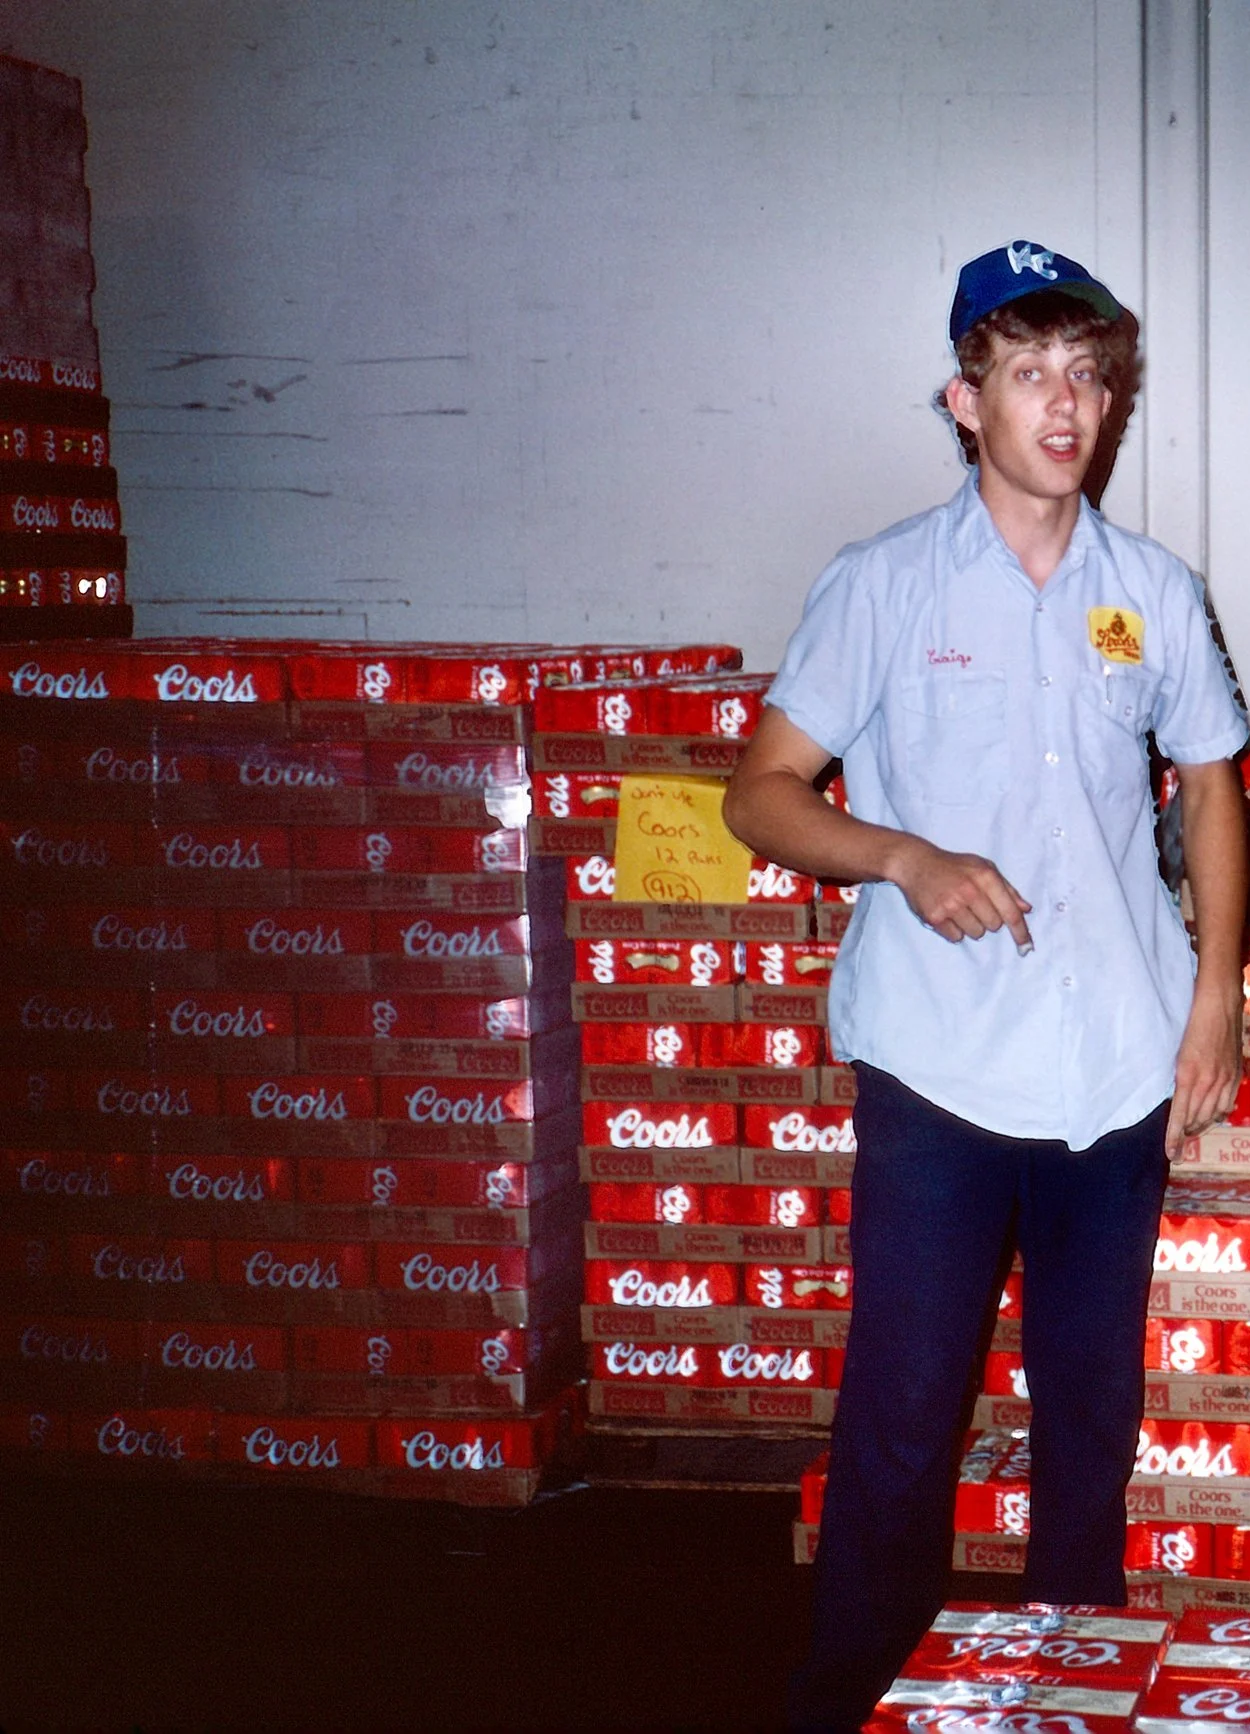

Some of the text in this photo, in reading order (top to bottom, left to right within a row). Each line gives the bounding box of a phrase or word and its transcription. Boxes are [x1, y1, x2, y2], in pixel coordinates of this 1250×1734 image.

[1007, 243, 1058, 281] KC
[53, 360, 96, 389] Coors
[13, 496, 59, 527] Coors
[70, 499, 115, 529] Coors
[10, 661, 108, 699] Coors
[154, 664, 257, 701] Coors
[85, 747, 181, 783] Coors
[239, 750, 339, 787] Coors
[395, 752, 495, 788] Coors
[638, 811, 700, 838] Coors
[165, 832, 262, 868] Coors
[656, 846, 679, 864] 12
[91, 914, 187, 949] Coors
[247, 919, 343, 955] Coors
[402, 921, 502, 957] Coors
[168, 1001, 266, 1036] Coors
[97, 1079, 191, 1115] Coors
[248, 1083, 346, 1120] Coors
[406, 1086, 505, 1124] Coors
[606, 1108, 713, 1148] Coors
[1219, 1150, 1228, 1162] is
[166, 1164, 265, 1201] Coors
[92, 1246, 186, 1282] Coors
[244, 1251, 340, 1288] Coors
[402, 1253, 500, 1293] Coors
[609, 1270, 712, 1308] Coors
[1182, 1297, 1250, 1314] is the one.
[1195, 1285, 1237, 1299] Coors
[161, 1332, 256, 1369] Coors
[604, 1342, 698, 1376] Coors
[718, 1344, 813, 1380] Coors
[1188, 1399, 1199, 1412] is
[1202, 1399, 1224, 1412] the
[97, 1417, 185, 1458] Coors
[244, 1426, 340, 1466] Coors
[402, 1431, 504, 1469] Coors
[1176, 1502, 1245, 1517] is the one.
[1189, 1490, 1232, 1503] Coors
[948, 1636, 1121, 1667] Coors
